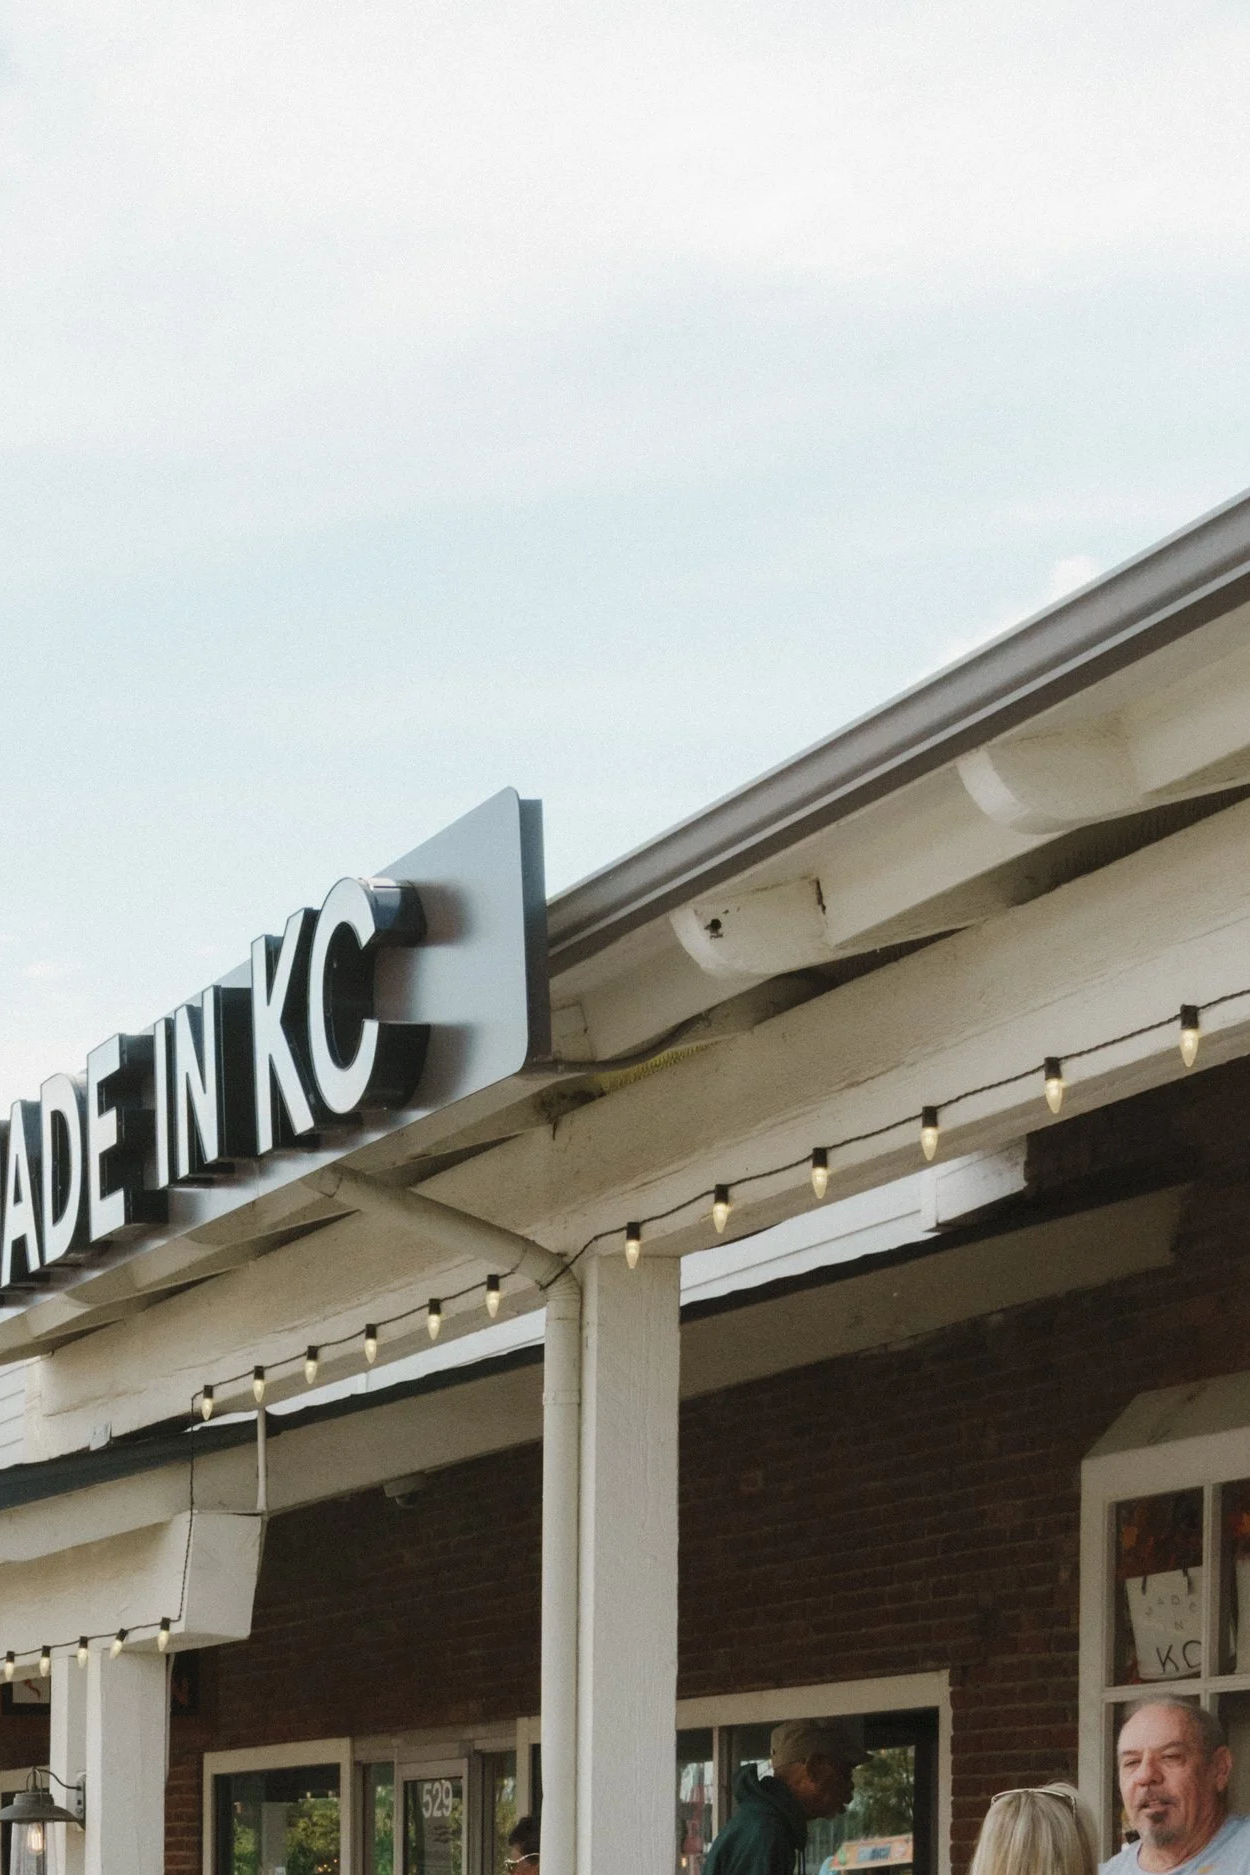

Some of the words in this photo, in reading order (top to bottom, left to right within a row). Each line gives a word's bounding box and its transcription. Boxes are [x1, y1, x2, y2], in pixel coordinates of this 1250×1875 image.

[153, 985, 219, 1190] IN
[250, 877, 379, 1156] KC
[1156, 1640, 1201, 1674] KC
[422, 1780, 453, 1820] 529
